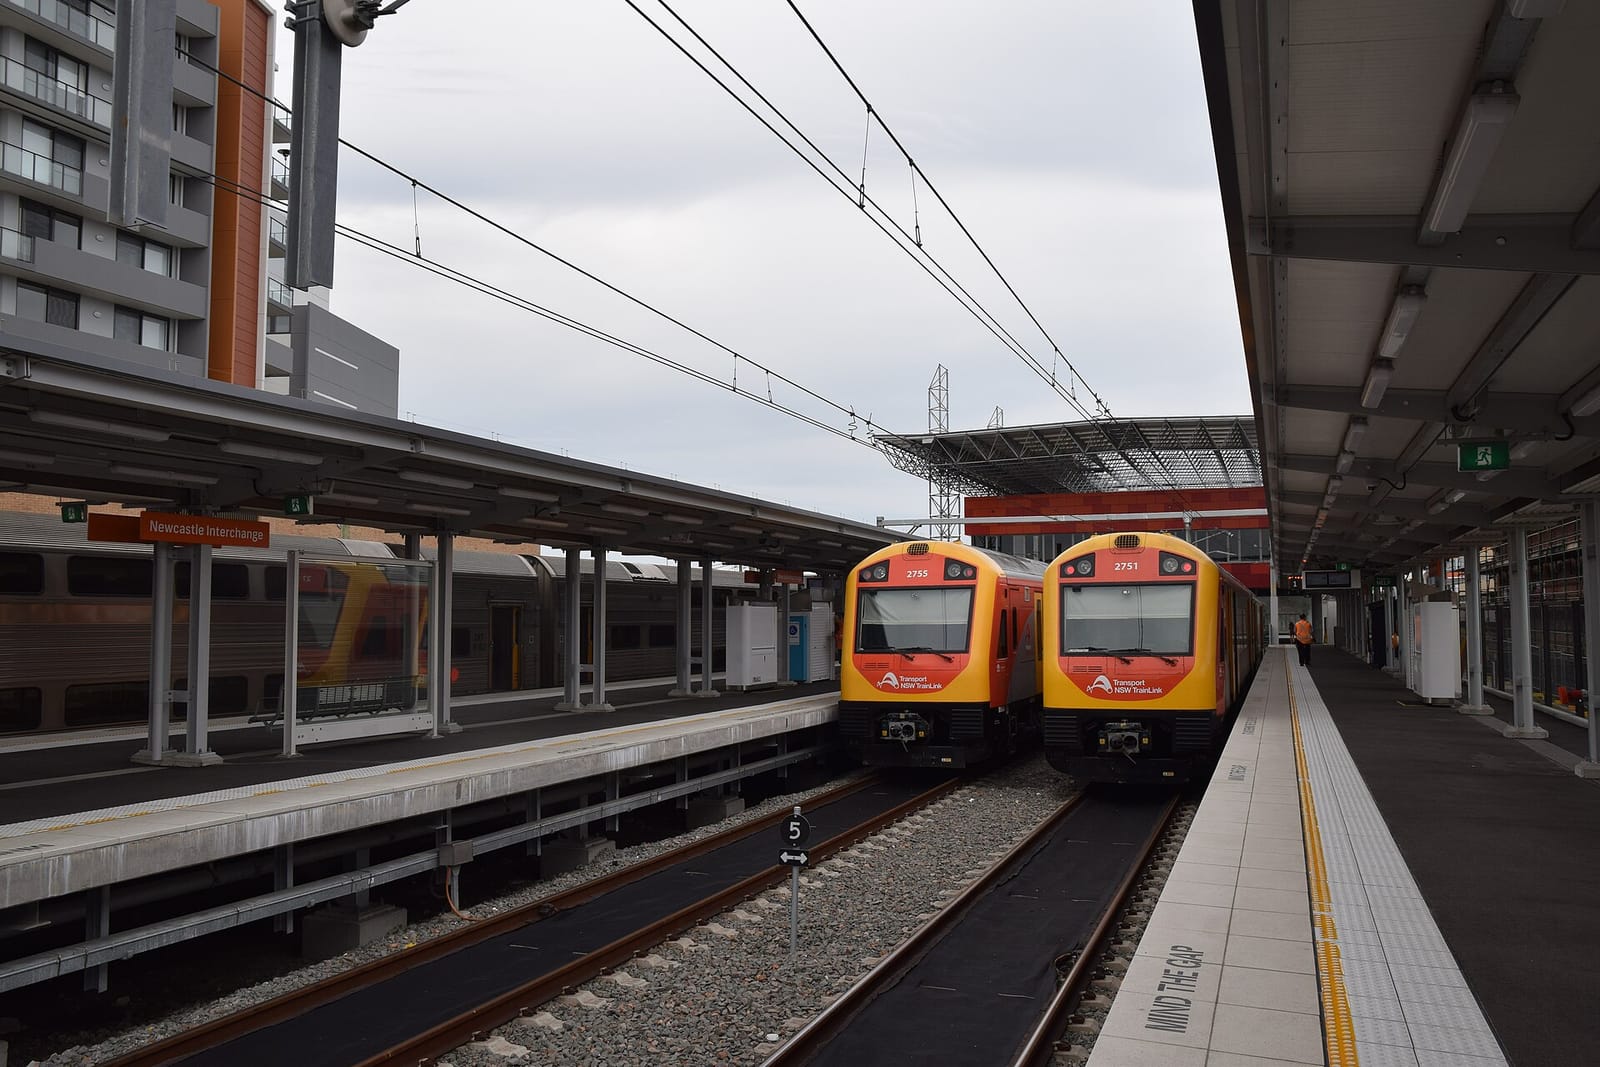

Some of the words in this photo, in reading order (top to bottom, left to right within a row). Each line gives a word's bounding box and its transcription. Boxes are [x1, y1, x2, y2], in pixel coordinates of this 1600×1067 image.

[150, 519, 204, 536] Newcastle
[206, 525, 264, 542] Interchange
[906, 569, 929, 578] 2755
[1114, 562, 1138, 571] 2751
[899, 675, 927, 683] Transport
[1113, 679, 1145, 687] Transport
[1132, 686, 1163, 694] TrainLink
[789, 821, 801, 840] 5
[1166, 945, 1204, 968] GAP
[1157, 968, 1199, 993] THE
[1144, 995, 1192, 1034] MIND
